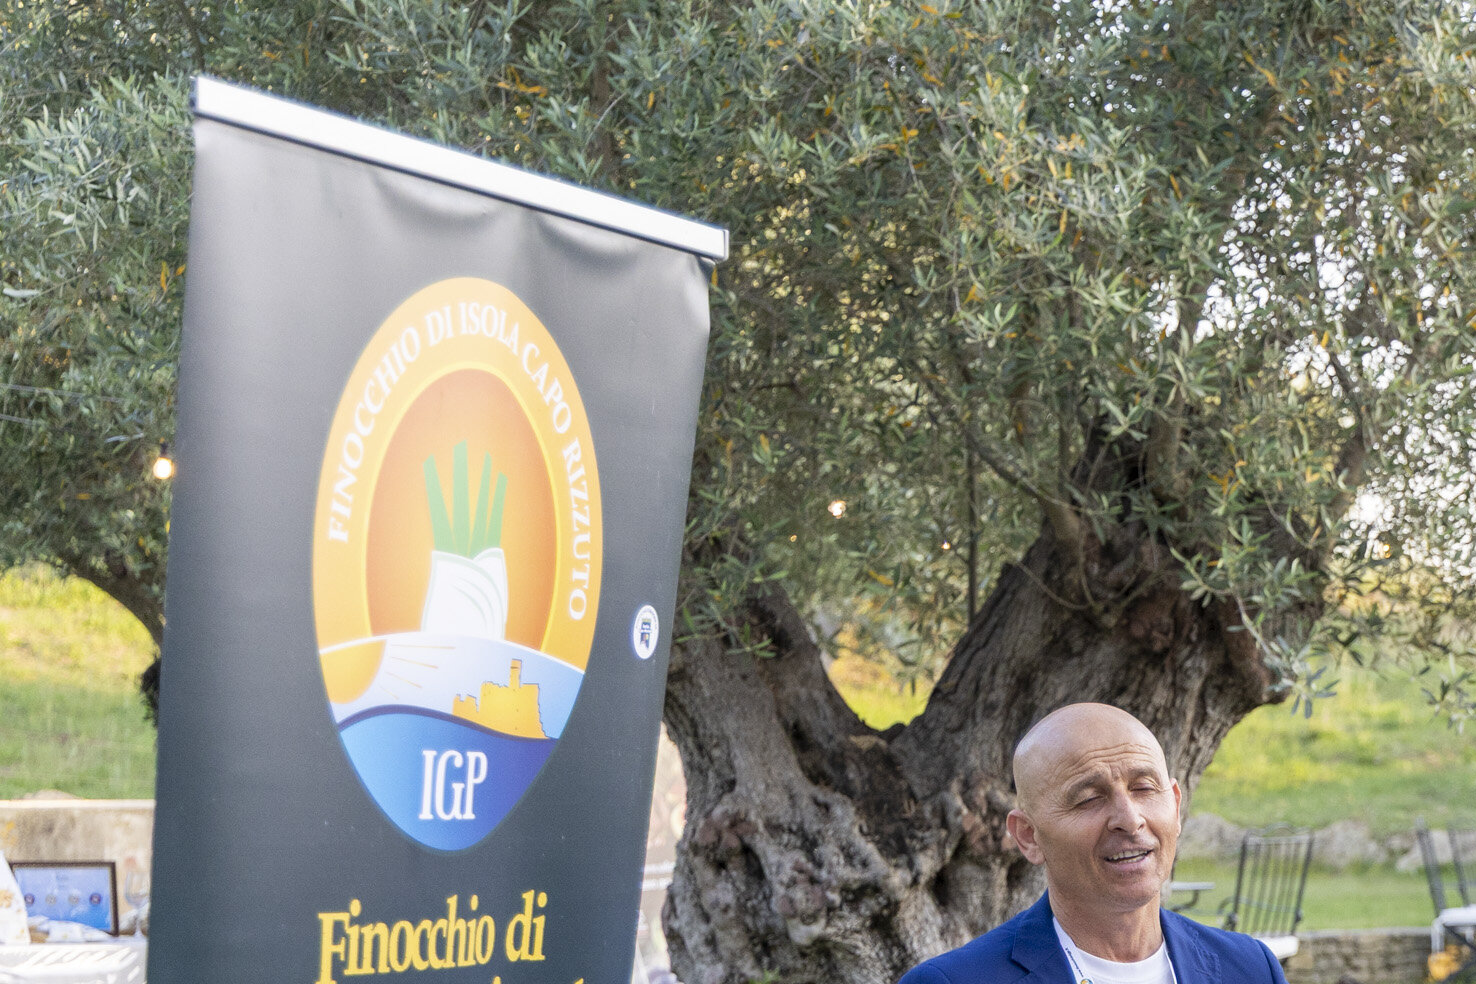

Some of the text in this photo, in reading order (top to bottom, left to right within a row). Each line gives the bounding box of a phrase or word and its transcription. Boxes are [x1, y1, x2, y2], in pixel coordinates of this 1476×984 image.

[328, 301, 592, 621] FINOCCHIO DI ISOLA CAPO RIZZUTO
[418, 749, 488, 820] IGP
[505, 889, 548, 962] di
